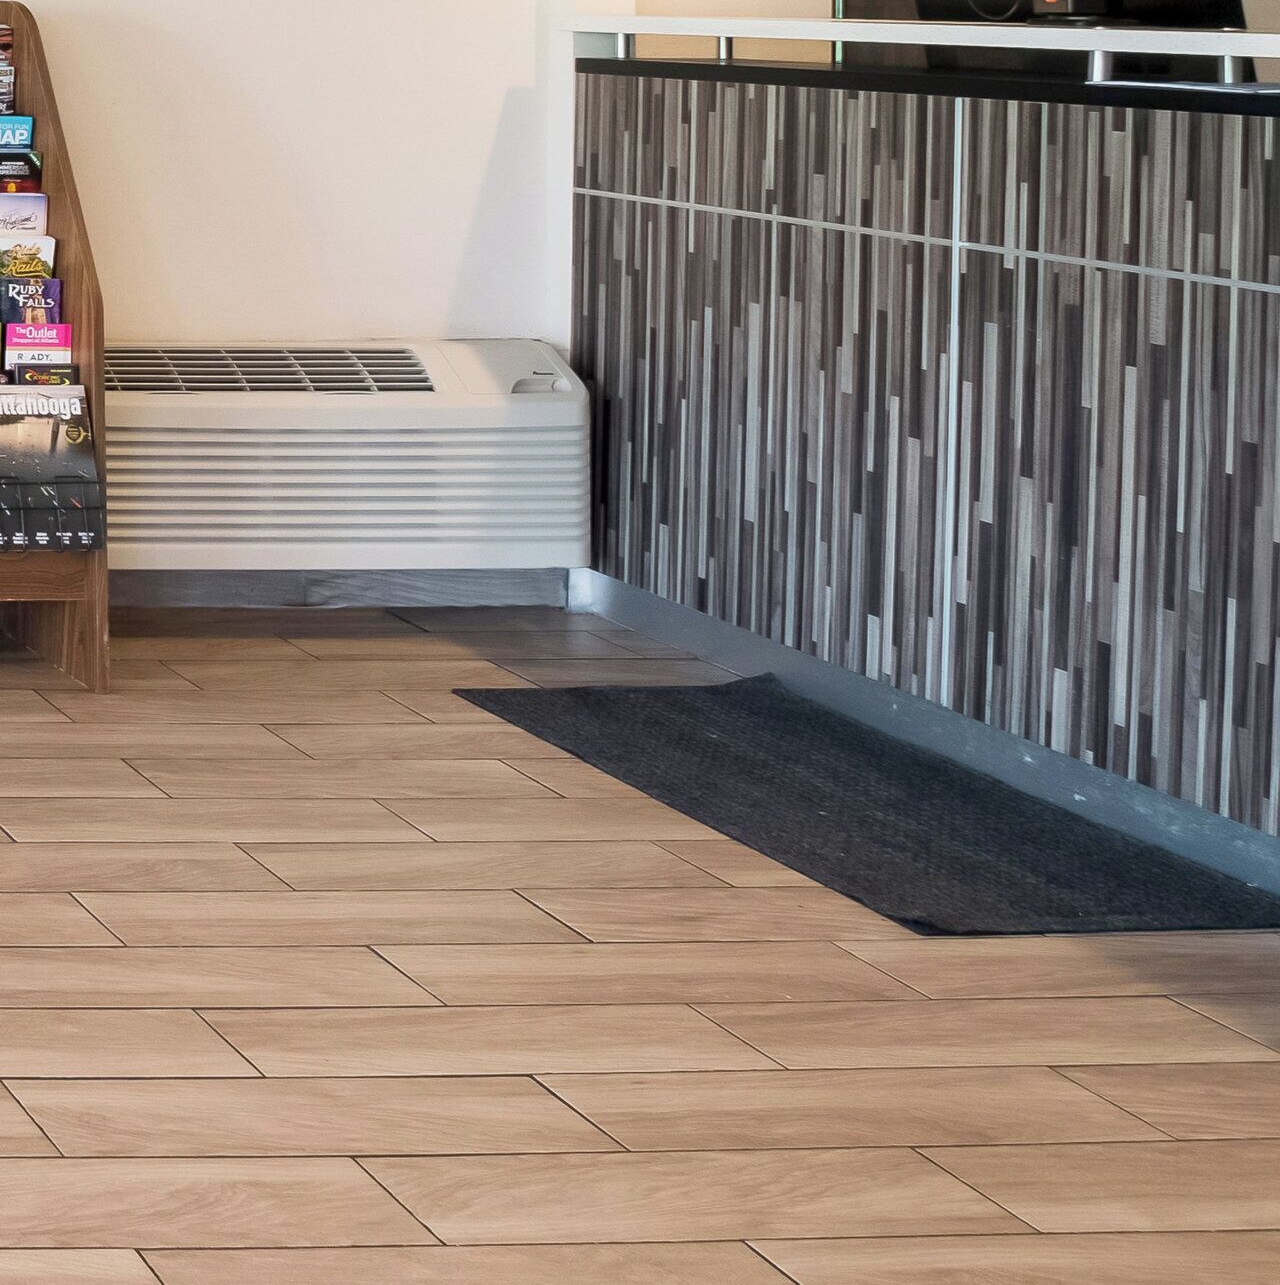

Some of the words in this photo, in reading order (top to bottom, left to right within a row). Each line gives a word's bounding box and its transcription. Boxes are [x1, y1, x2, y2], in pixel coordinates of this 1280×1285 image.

[8, 283, 46, 299] RUBY
[19, 295, 55, 308] FALLS
[26, 327, 57, 338] Outlet
